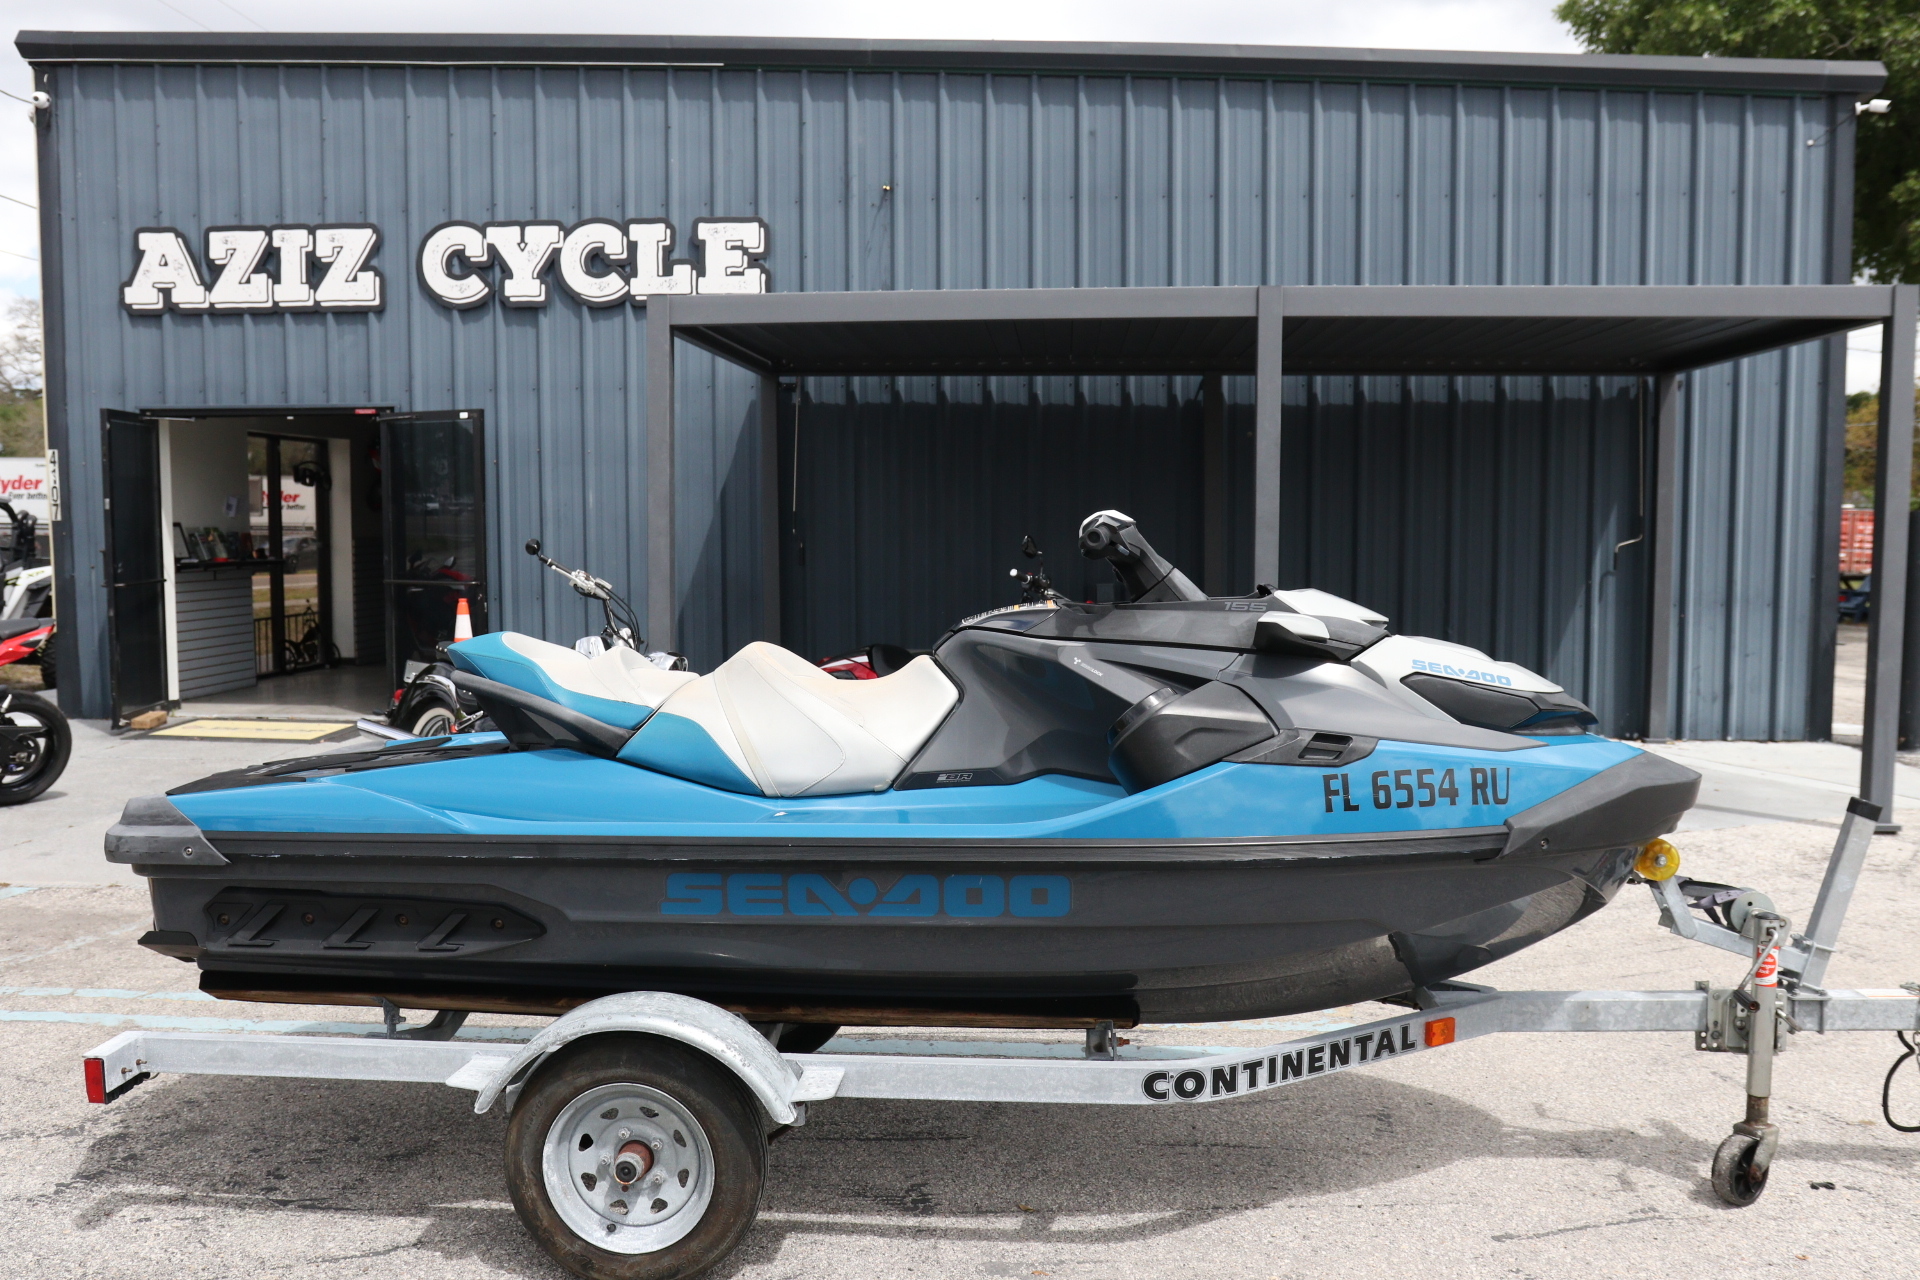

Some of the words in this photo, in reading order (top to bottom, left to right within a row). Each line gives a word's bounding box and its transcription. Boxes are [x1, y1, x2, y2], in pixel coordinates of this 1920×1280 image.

[123, 227, 381, 310] AZIZ
[421, 222, 766, 304] CYCLE
[0, 474, 43, 494] yder
[1224, 602, 1267, 611] 155
[1322, 773, 1359, 813] FL
[1371, 768, 1459, 810] 6554
[1470, 767, 1511, 806] RU
[1140, 1023, 1418, 1101] CONTINENTAL
